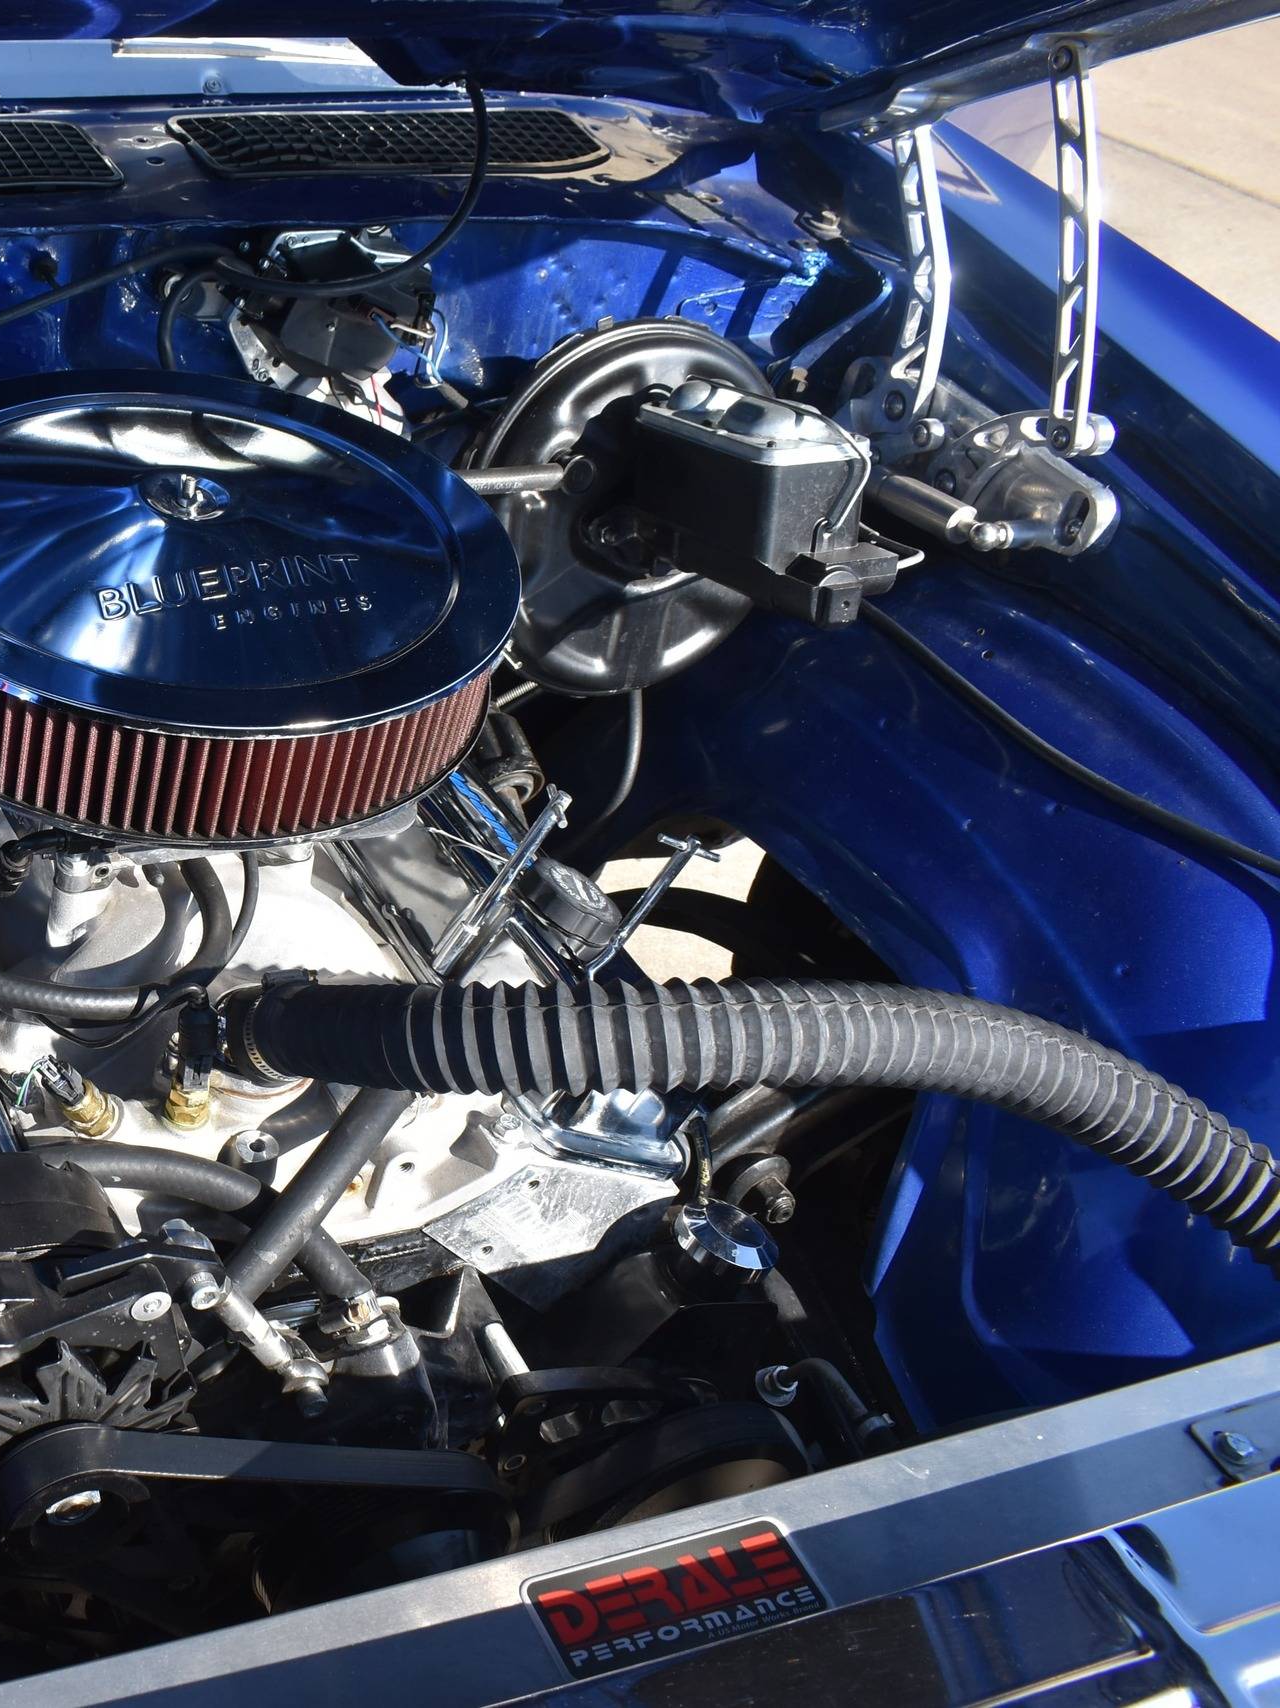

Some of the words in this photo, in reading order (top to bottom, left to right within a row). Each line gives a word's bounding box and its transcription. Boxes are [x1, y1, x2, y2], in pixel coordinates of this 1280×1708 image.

[95, 553, 360, 621] BLUEPRINT
[212, 593, 372, 631] ENGINES
[537, 1531, 802, 1646] DERALE
[761, 1610, 790, 1624] Works
[792, 1601, 820, 1615] Brand
[569, 1585, 818, 1668] PERFORMANCE
